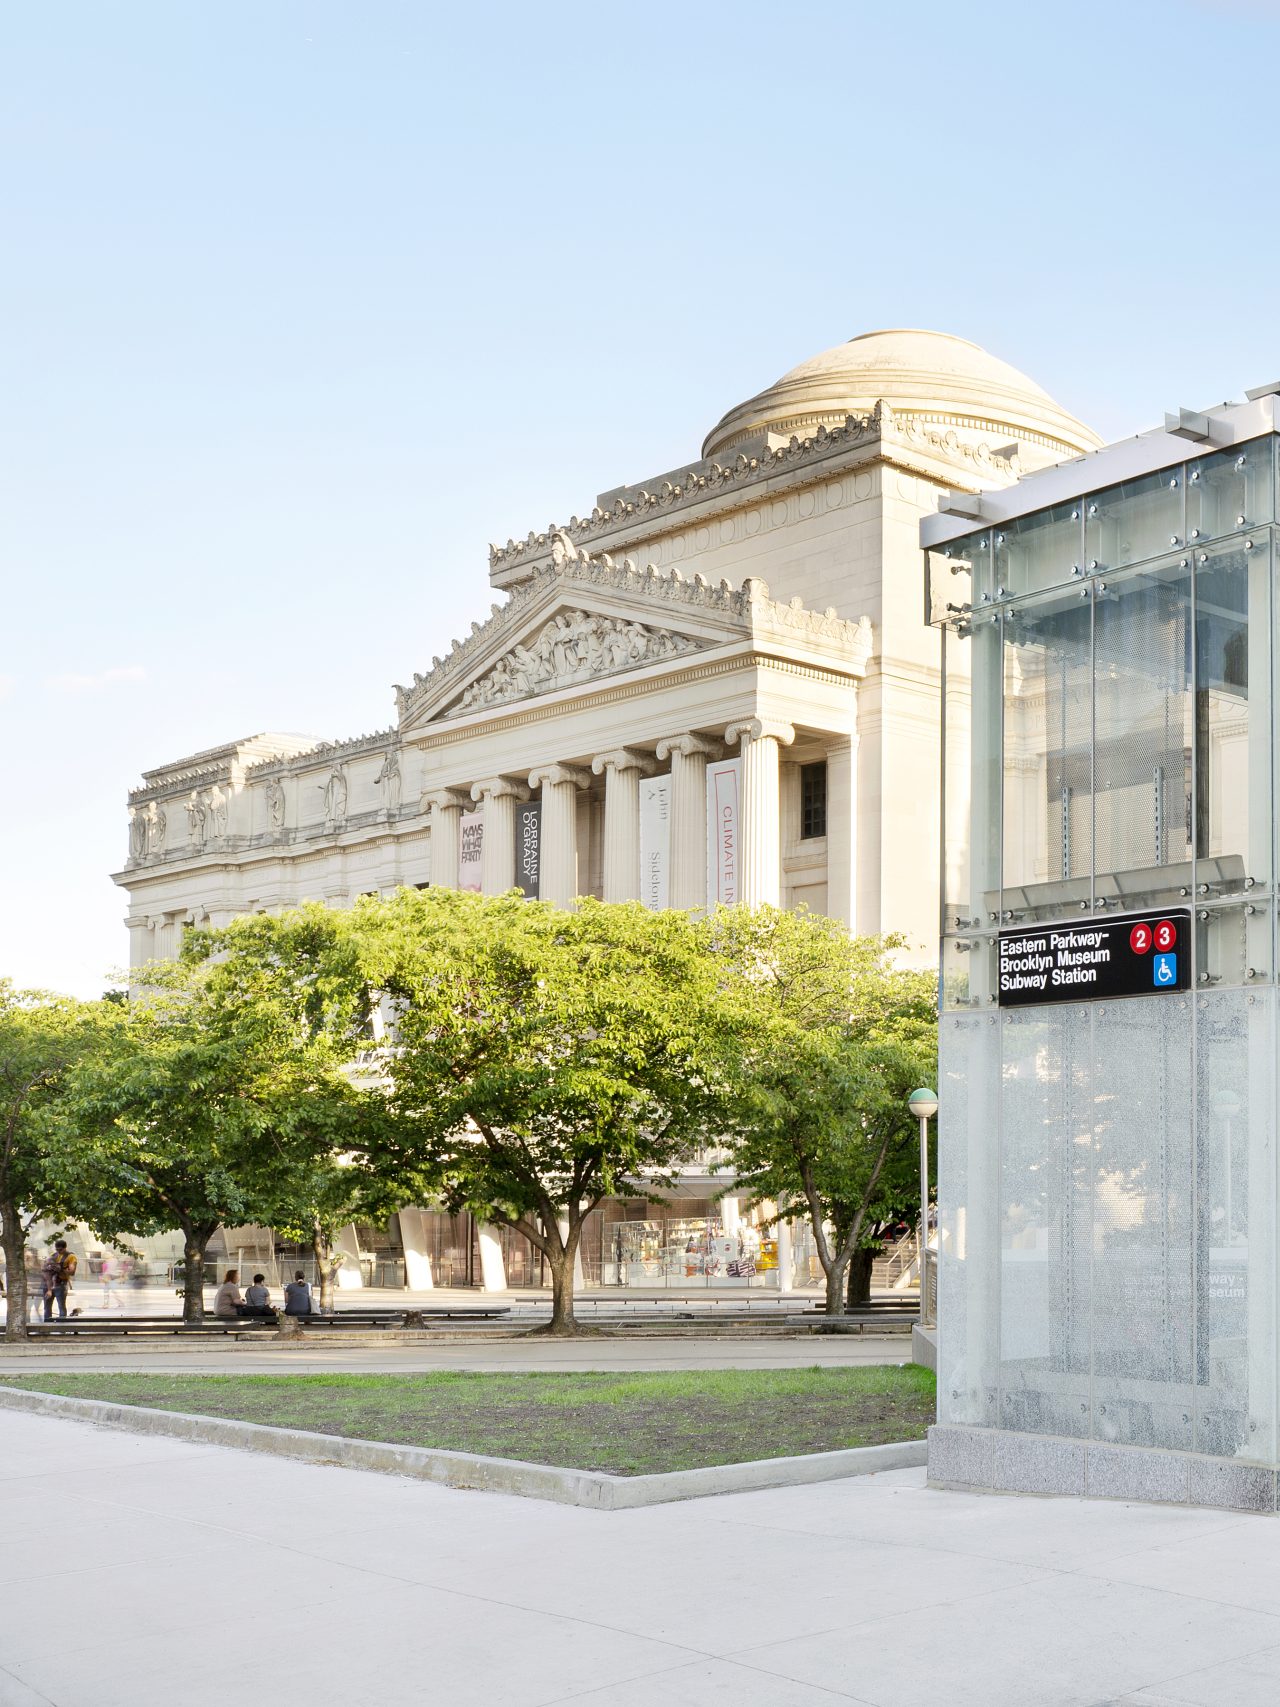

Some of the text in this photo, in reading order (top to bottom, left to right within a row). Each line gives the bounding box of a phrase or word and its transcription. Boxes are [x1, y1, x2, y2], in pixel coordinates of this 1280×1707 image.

[657, 786, 669, 820] John
[462, 823, 484, 838] KAWS
[462, 836, 483, 851] WHAT
[522, 812, 531, 876] O'GRADY
[530, 811, 538, 884] LORRAINE
[722, 806, 734, 905] CLIMATE IN
[461, 849, 482, 864] PARTY
[648, 851, 661, 911] Sidelong
[1000, 932, 1110, 956] Eastern Parkway-
[1136, 926, 1170, 948] 2 3
[1000, 948, 1110, 973] Brooklyn Museum
[1000, 968, 1097, 990] Subway Station
